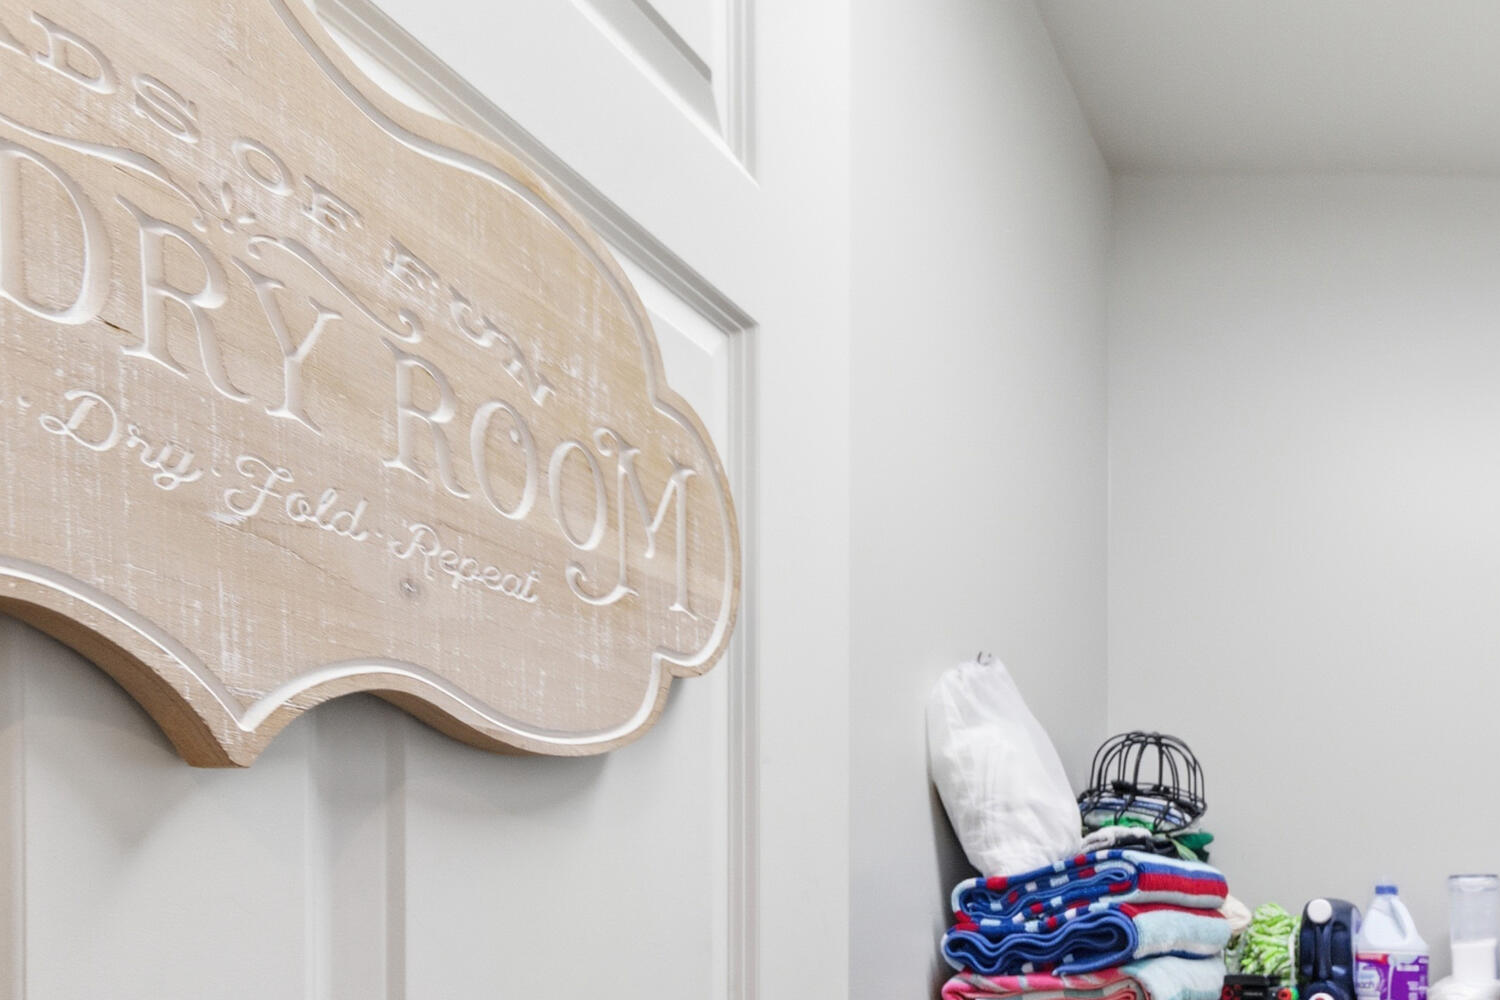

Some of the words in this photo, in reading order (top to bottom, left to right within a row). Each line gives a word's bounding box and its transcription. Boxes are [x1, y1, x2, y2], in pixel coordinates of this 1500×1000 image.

[0, 10, 200, 143] DS
[231, 137, 365, 234] OF
[38, 390, 203, 491] Dry
[222, 454, 370, 542] Fold
[387, 518, 540, 603] Repeat
[380, 336, 698, 620] ROOM
